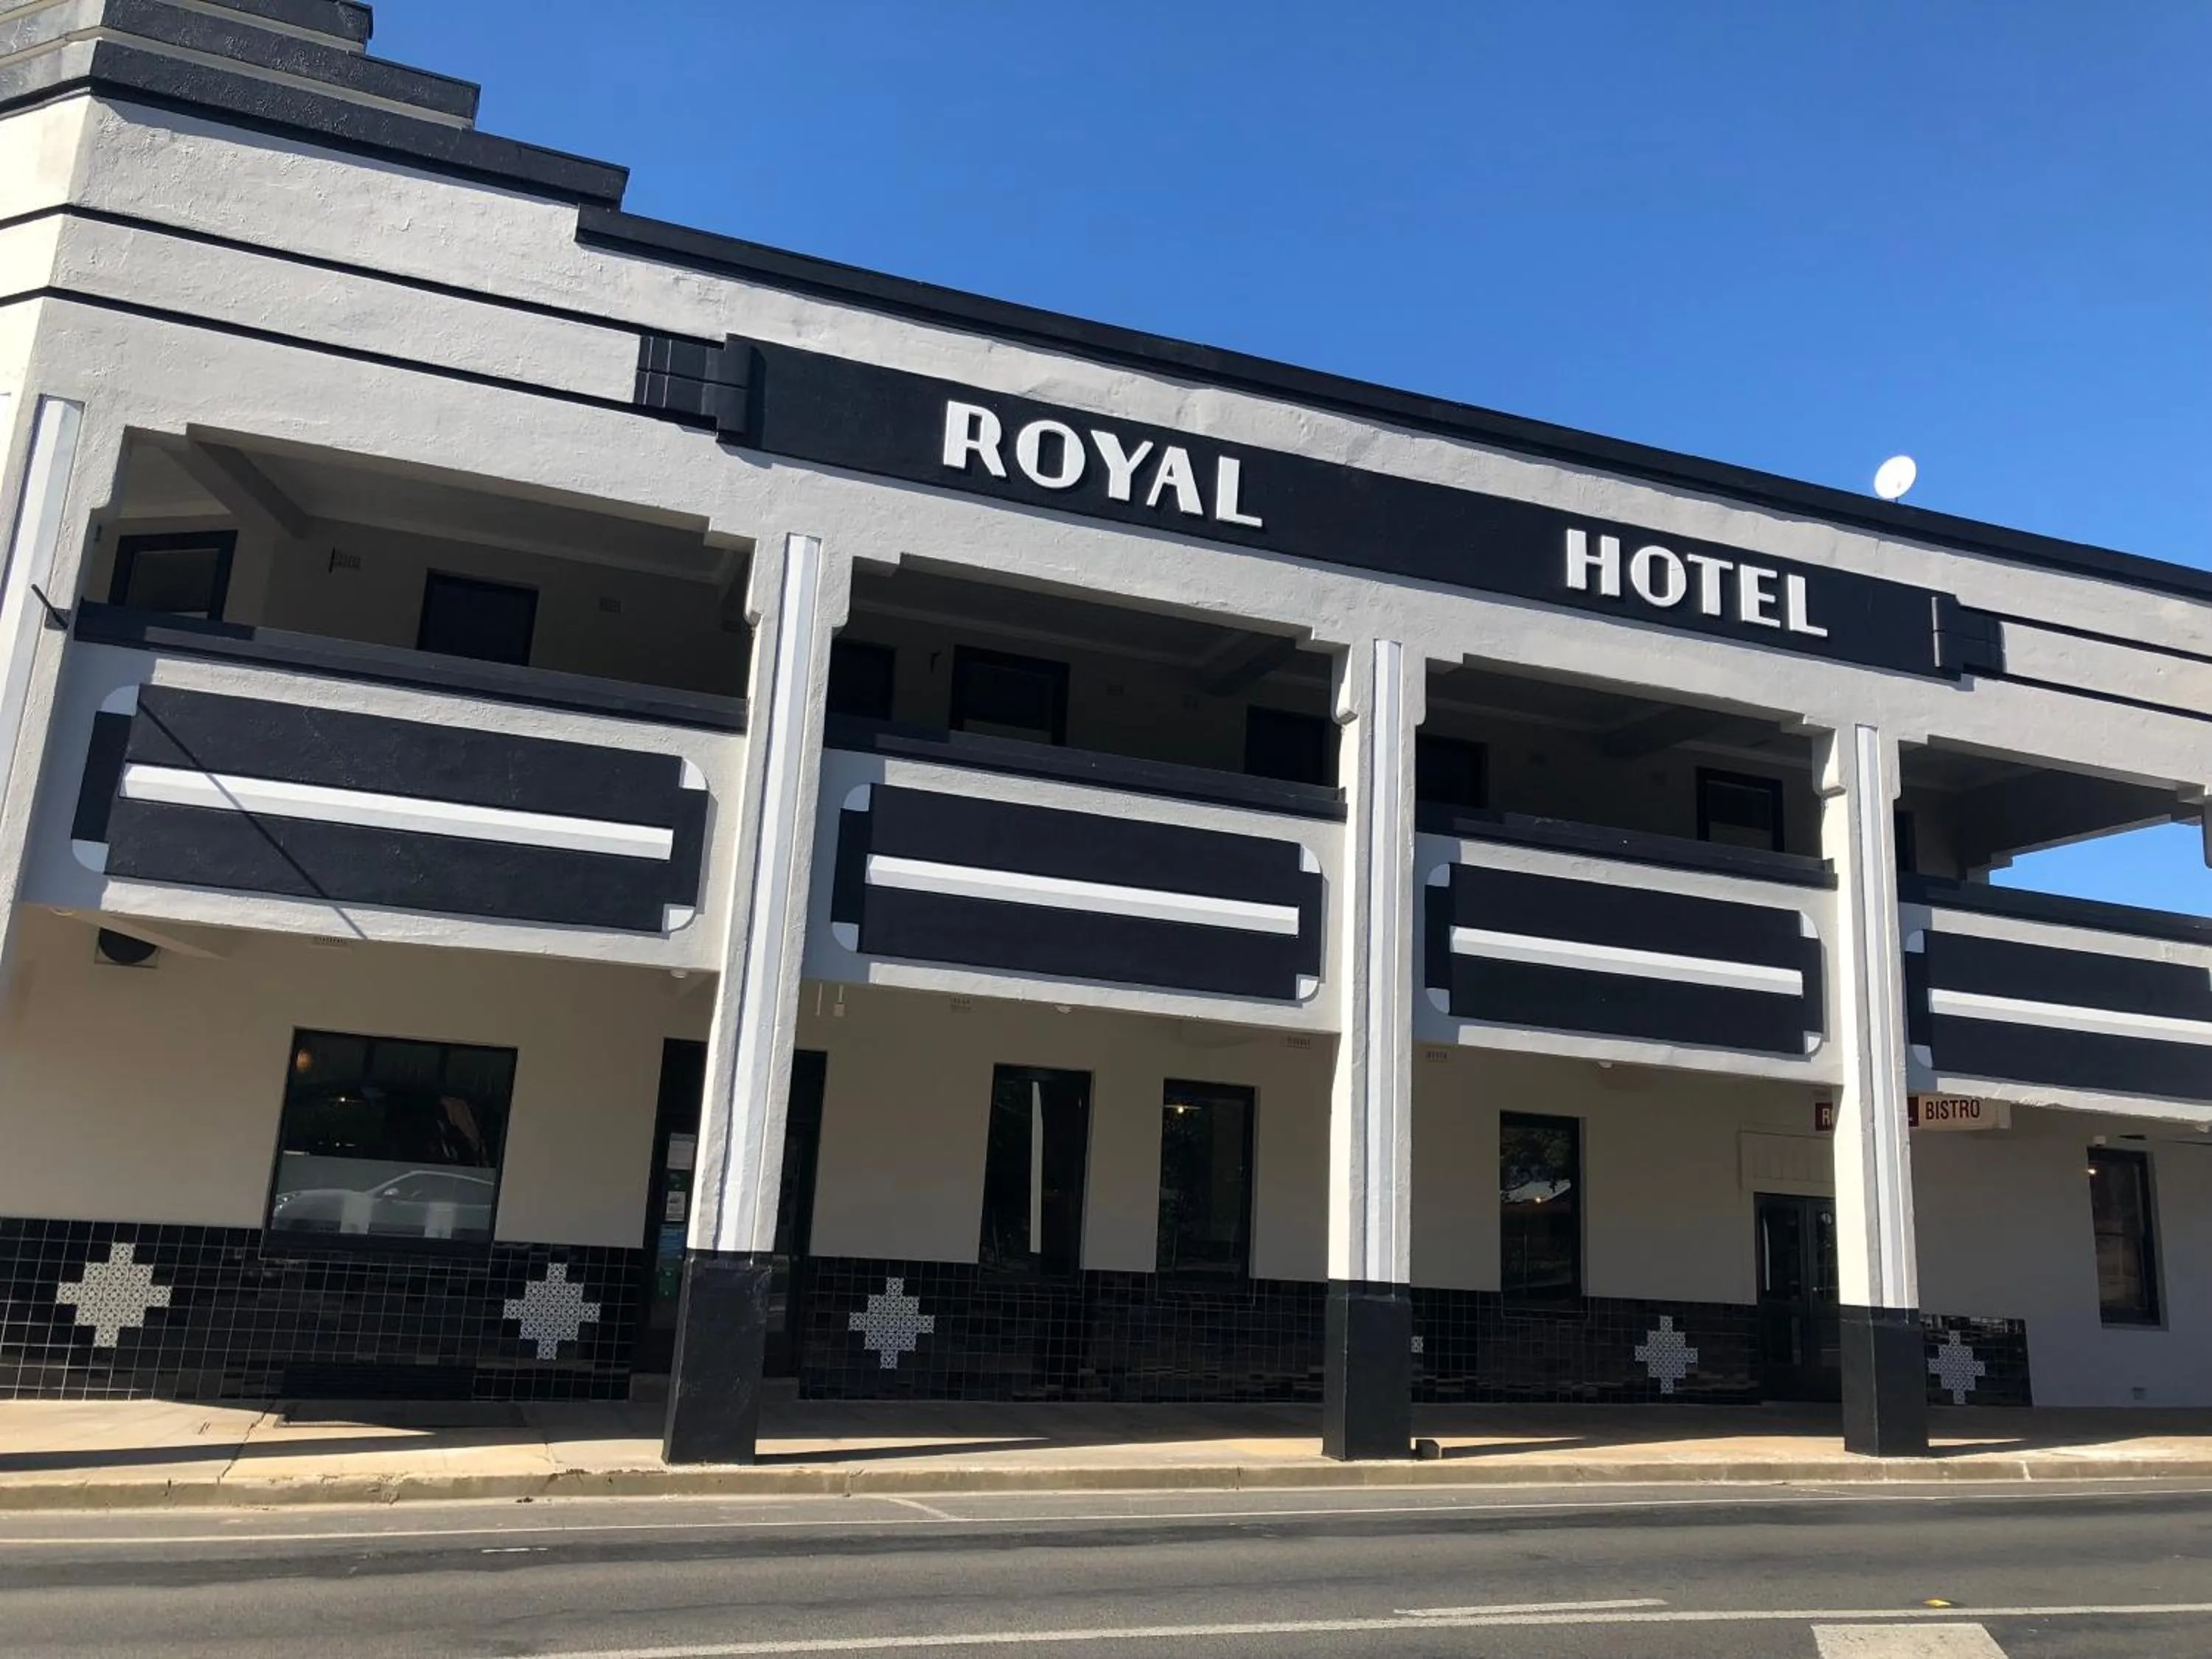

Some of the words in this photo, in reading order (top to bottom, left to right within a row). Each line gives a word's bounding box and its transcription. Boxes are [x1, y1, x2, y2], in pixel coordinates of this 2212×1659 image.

[943, 400, 1263, 528] ROYAL
[1566, 529, 1829, 637] HOTEL
[1925, 1099, 1980, 1120] BISTRO
